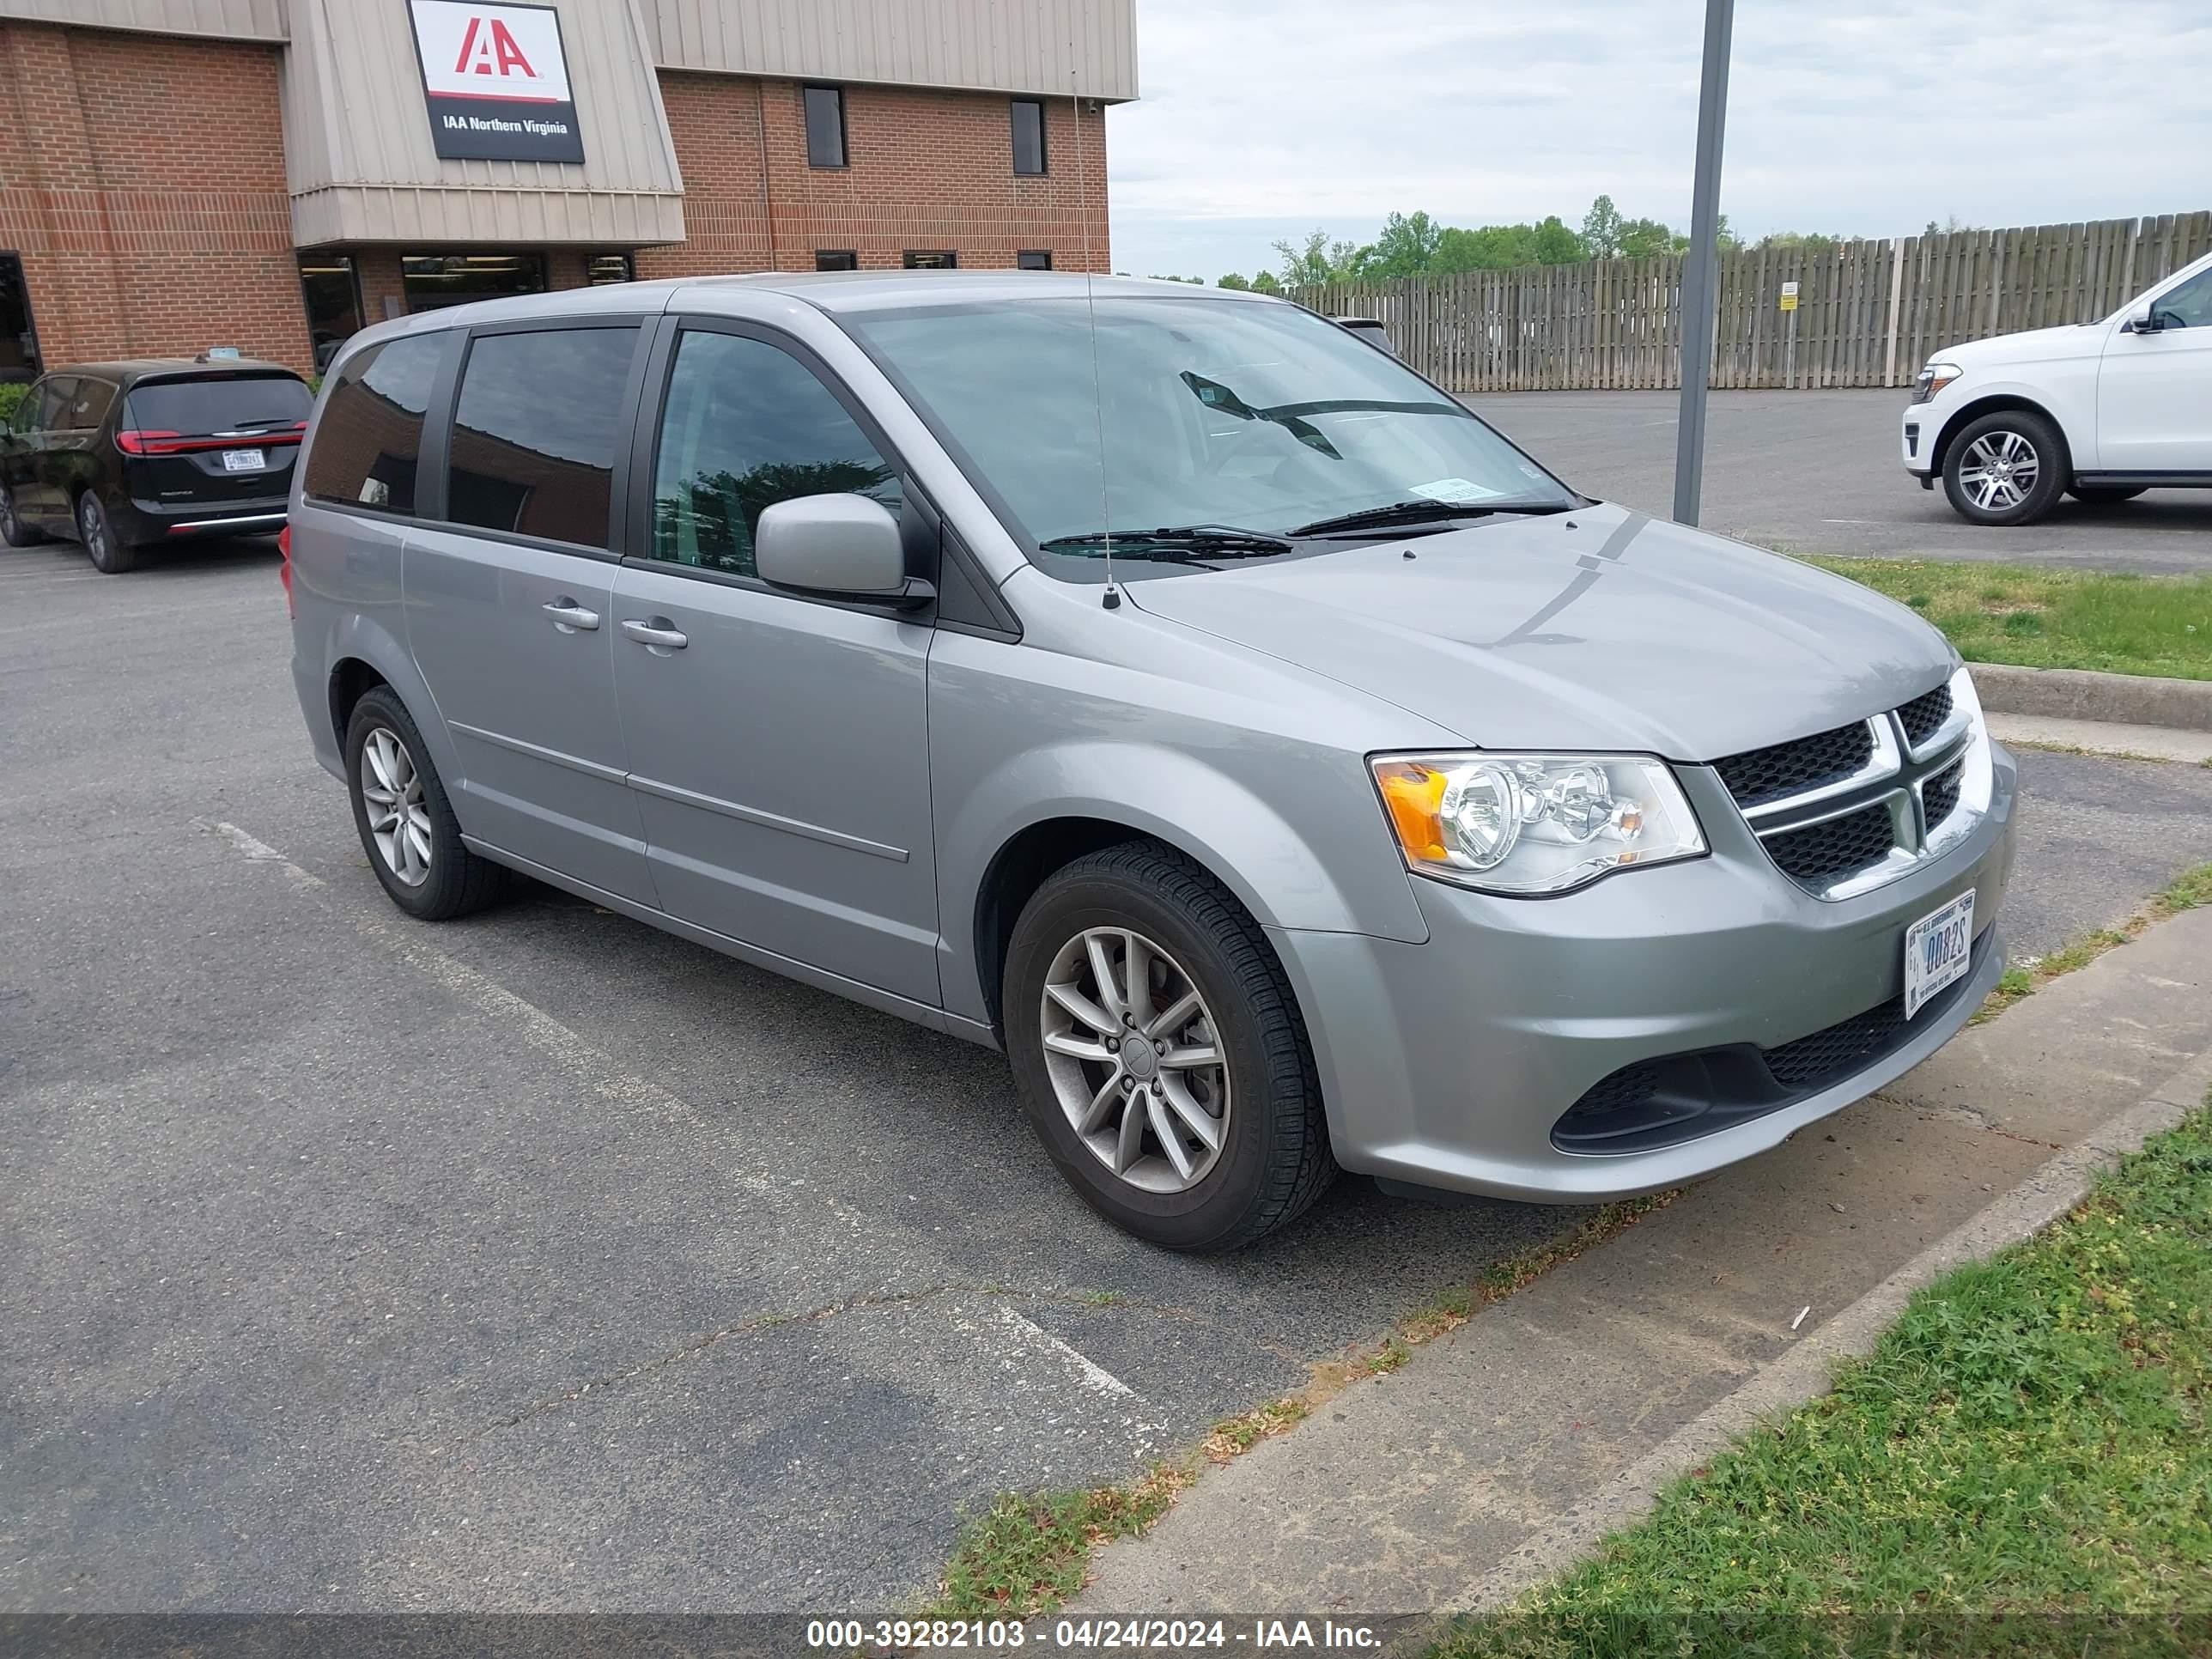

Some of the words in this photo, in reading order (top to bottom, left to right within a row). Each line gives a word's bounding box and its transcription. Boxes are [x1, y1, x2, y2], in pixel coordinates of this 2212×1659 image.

[443, 115, 468, 129] IAA
[469, 117, 522, 132] Northern
[523, 119, 568, 135] Virginia
